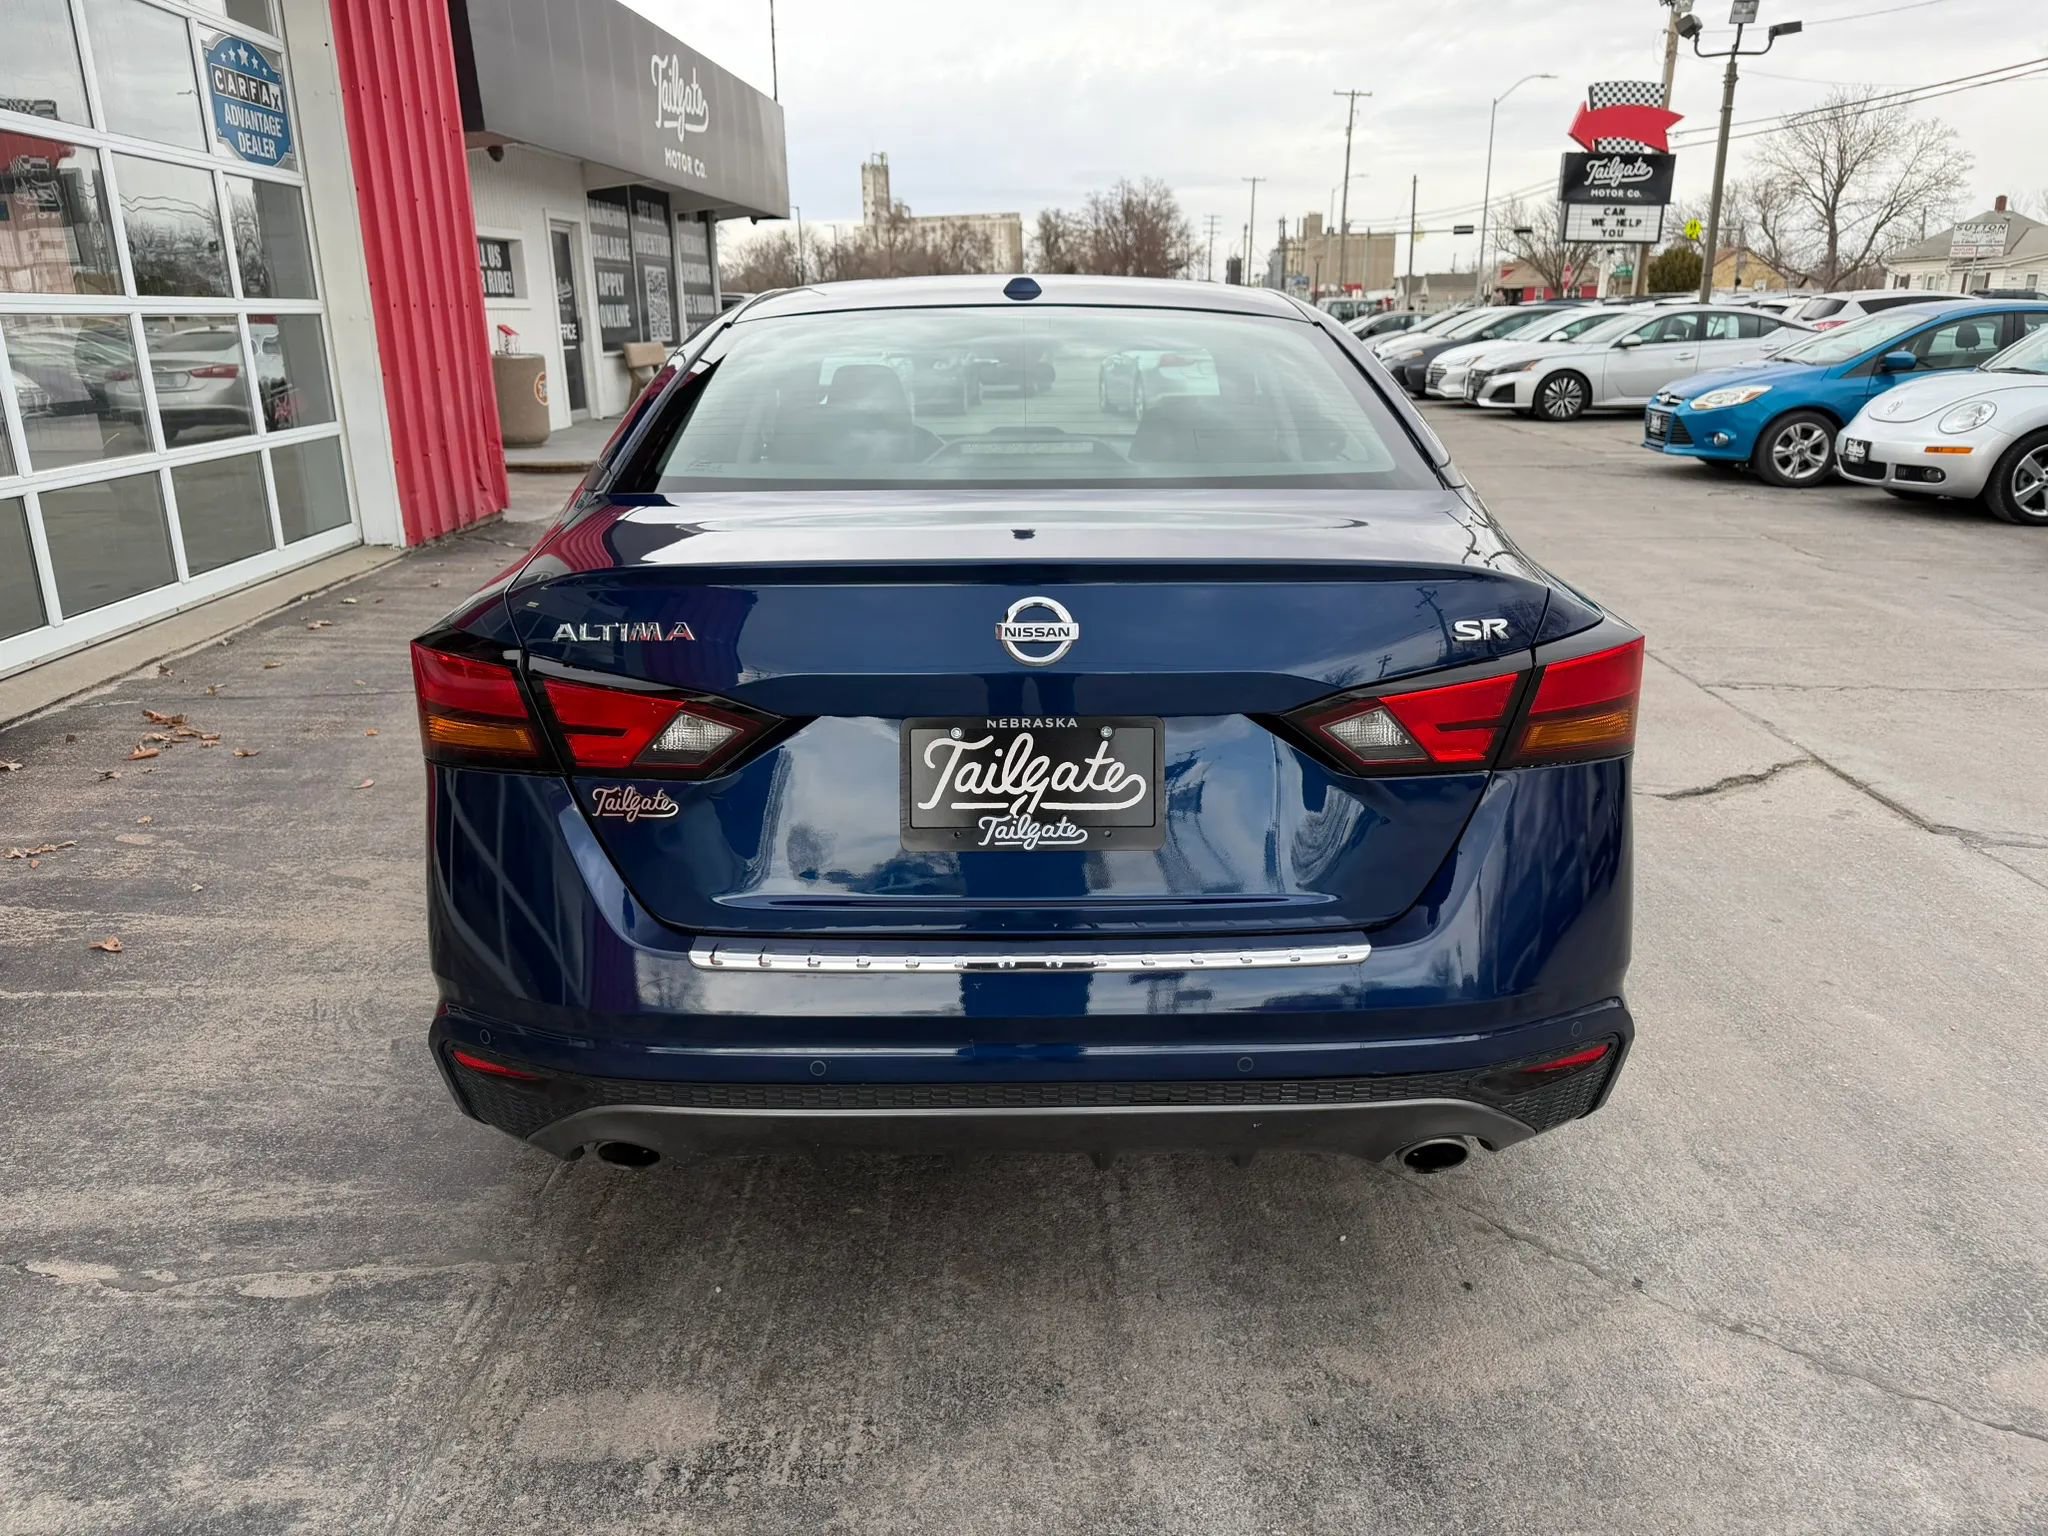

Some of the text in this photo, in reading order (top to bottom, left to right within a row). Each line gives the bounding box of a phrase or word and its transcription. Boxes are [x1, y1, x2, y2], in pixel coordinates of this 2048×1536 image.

[214, 69, 282, 111] CARFAX
[651, 54, 709, 142] Tailgate
[224, 103, 283, 138] ADVANTAGE
[237, 131, 278, 160] DEALER
[664, 147, 694, 175] MOTOR
[1583, 156, 1654, 187] Tailgate
[1590, 188, 1624, 198] MOTOR
[1591, 217, 1642, 227] WE HELP
[1603, 207, 1626, 216] CAN
[1601, 228, 1624, 238] YOU
[487, 244, 502, 267] US
[486, 270, 513, 293] RIDE!
[598, 271, 625, 296] APPLY
[600, 304, 631, 328] ONLINE
[560, 323, 578, 341] FFICE
[552, 622, 696, 642] ALTIMA
[1004, 627, 1070, 638] NISSAN
[1453, 618, 1510, 641] SR
[986, 717, 1079, 729] NEBRASKA
[917, 732, 1147, 819] Tailgate
[592, 785, 680, 823] Tailgate
[978, 813, 1089, 850] Tailgate
